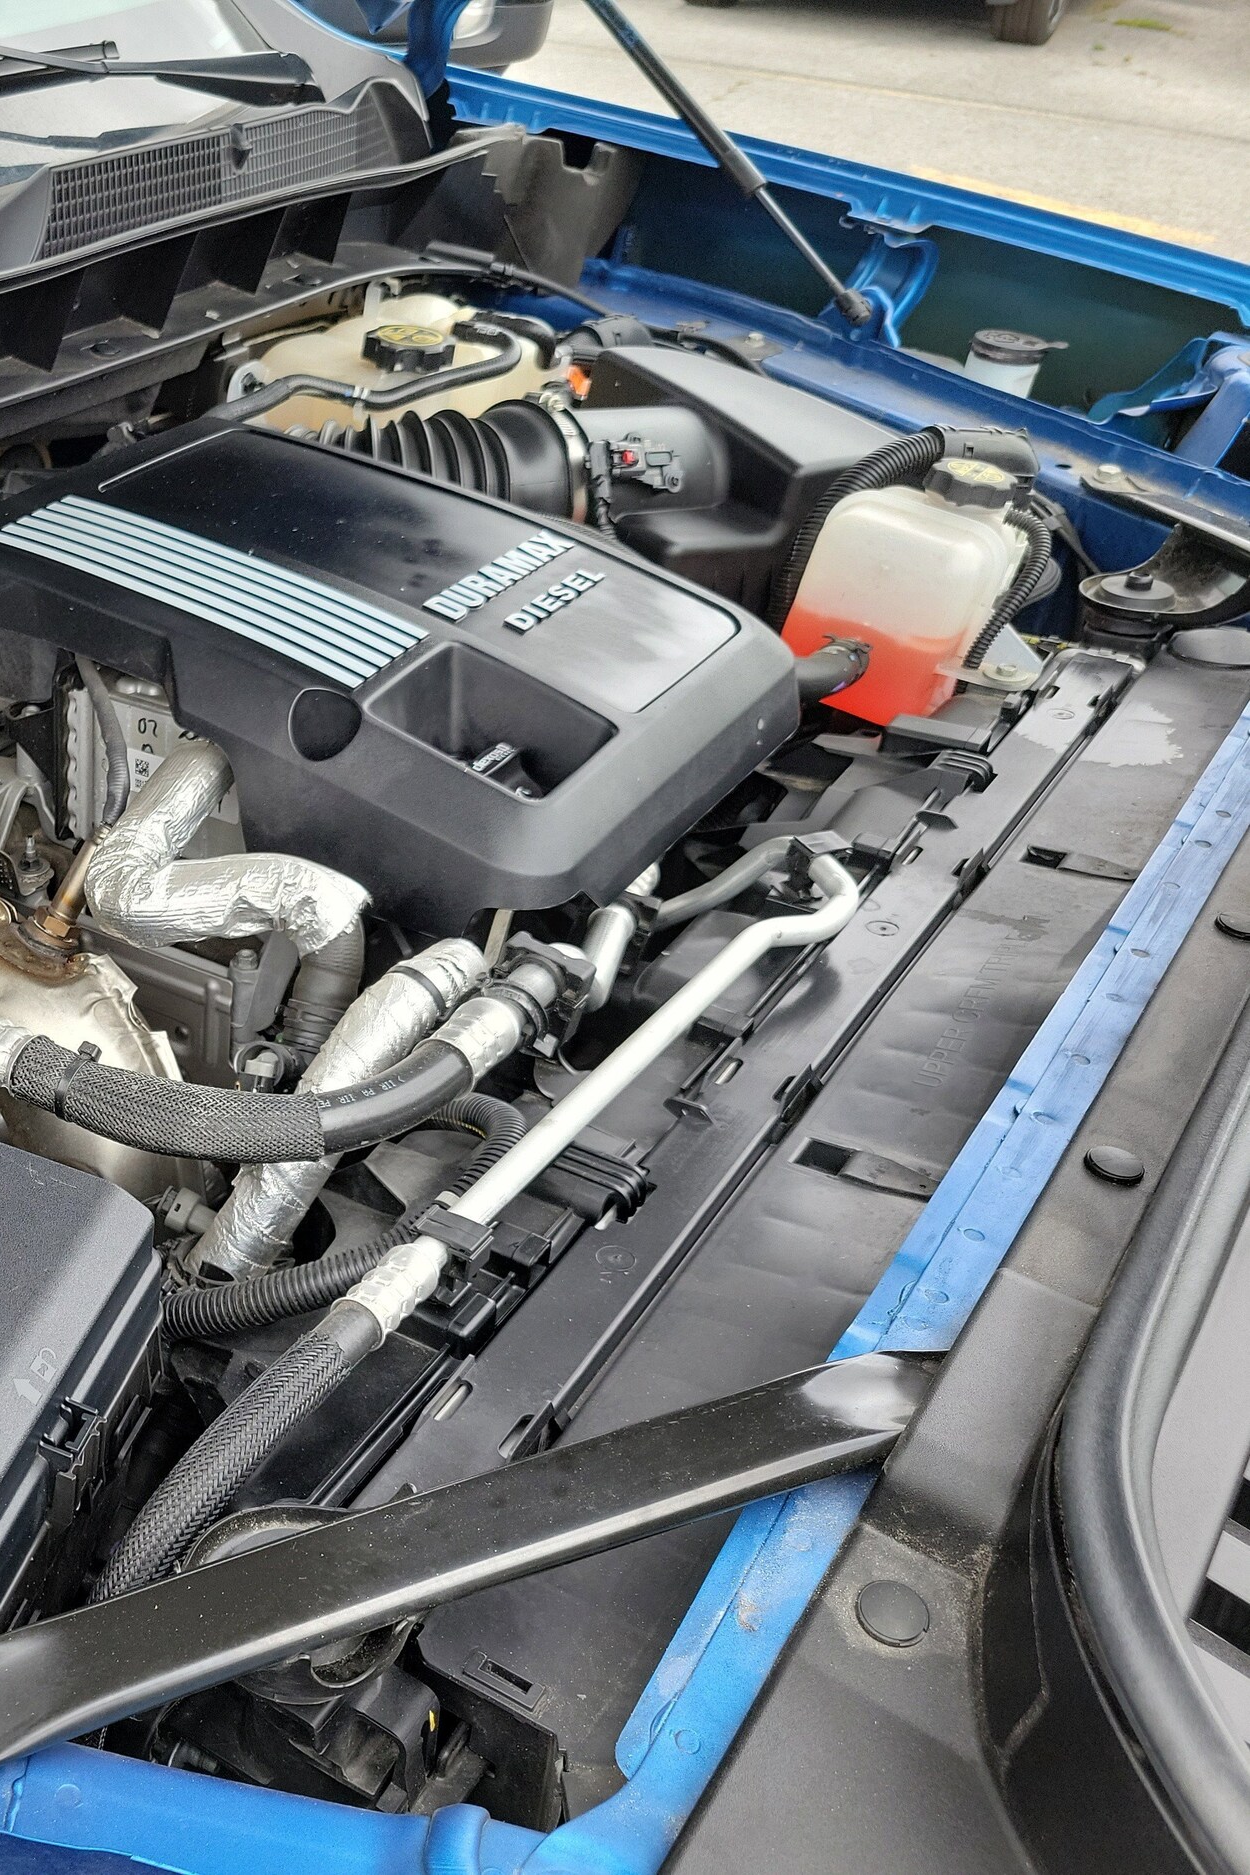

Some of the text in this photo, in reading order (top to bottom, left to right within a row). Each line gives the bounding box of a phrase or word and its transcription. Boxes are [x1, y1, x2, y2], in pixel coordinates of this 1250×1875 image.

[423, 530, 575, 622] DURAMAX
[504, 570, 606, 634] DIESEL
[138, 718, 158, 738] 07
[912, 1027, 971, 1089] UPPER
[361, 1088, 376, 1097] PA
